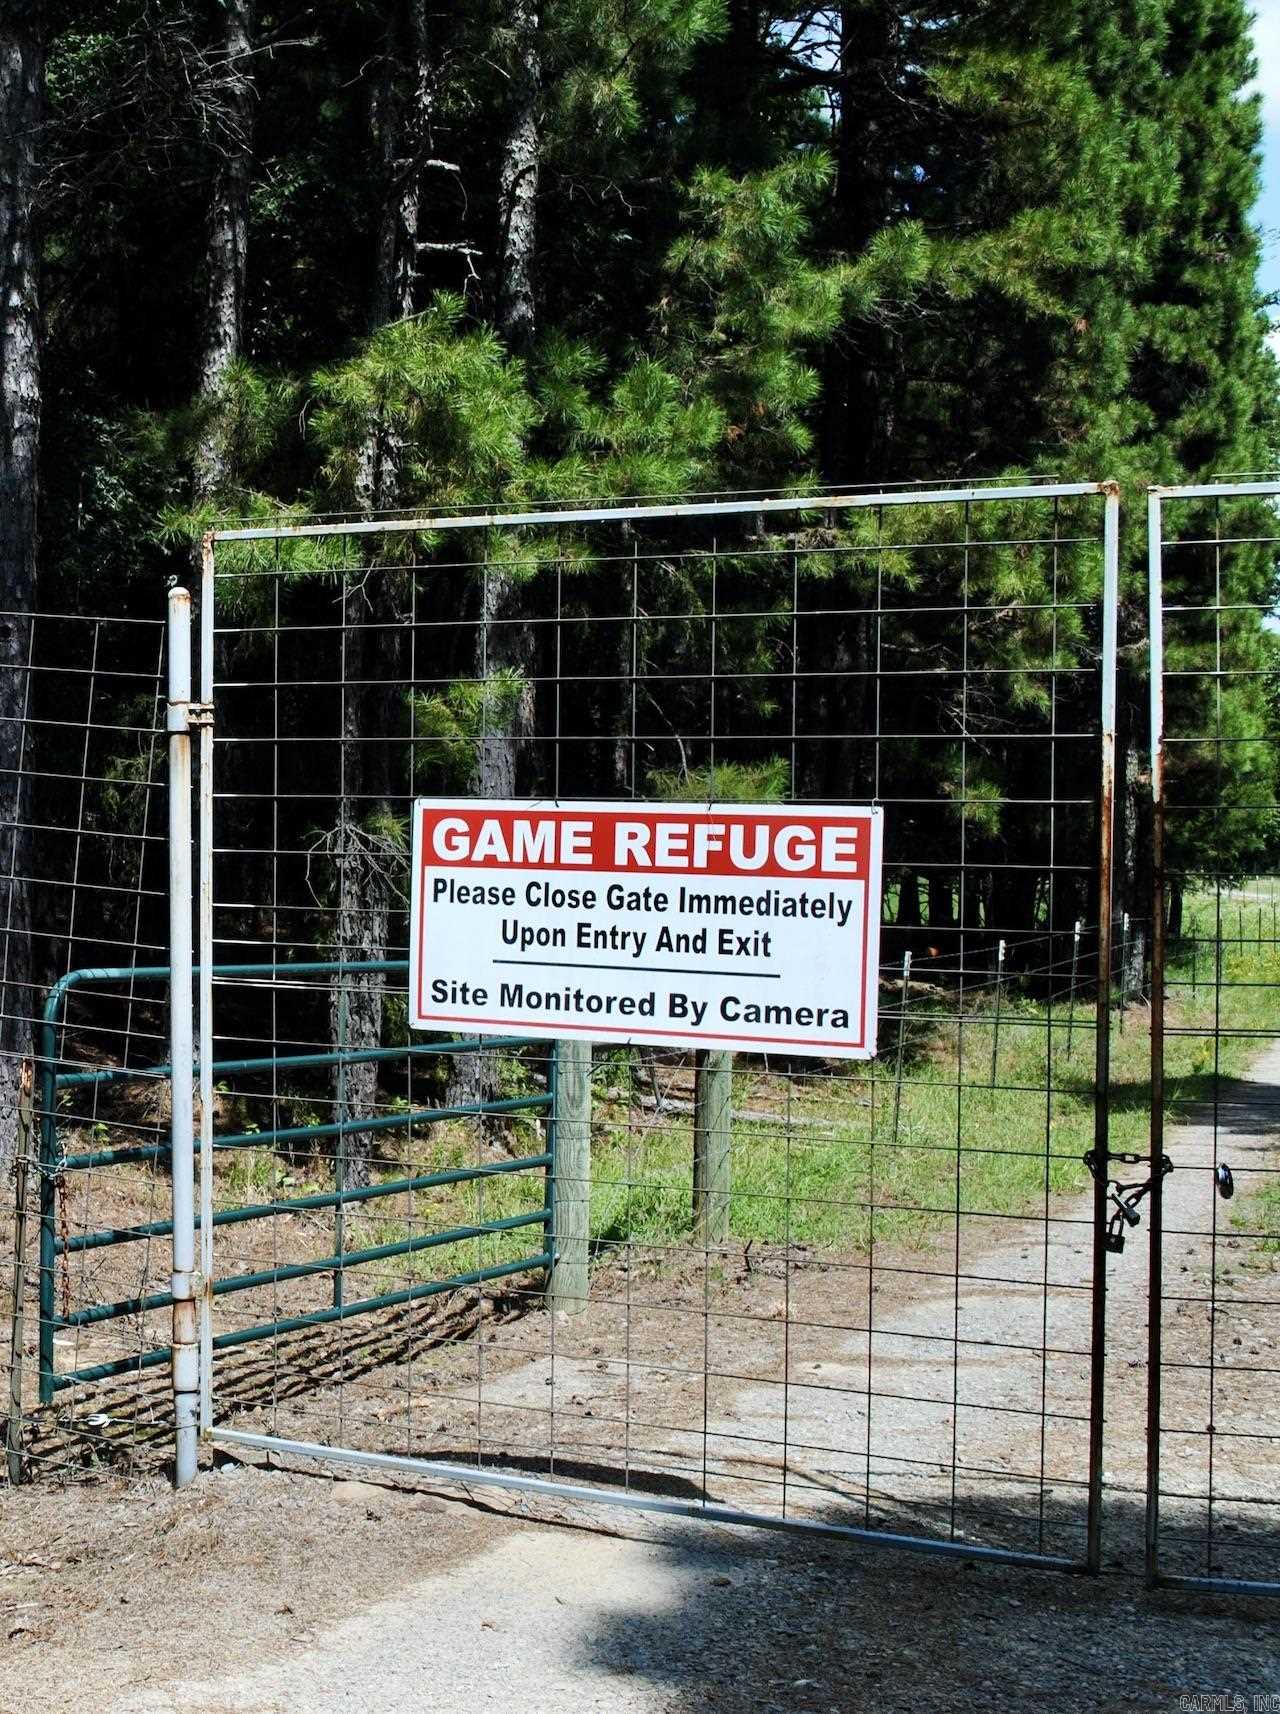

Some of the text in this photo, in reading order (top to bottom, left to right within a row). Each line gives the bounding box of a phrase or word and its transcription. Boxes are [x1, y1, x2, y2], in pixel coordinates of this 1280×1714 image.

[432, 817, 858, 873] GAME REFUGE
[433, 878, 852, 926] Please Close Gate Immediately
[501, 919, 771, 957] Upon Entry And Exit
[431, 979, 849, 1028] Site Monitored By Camera
